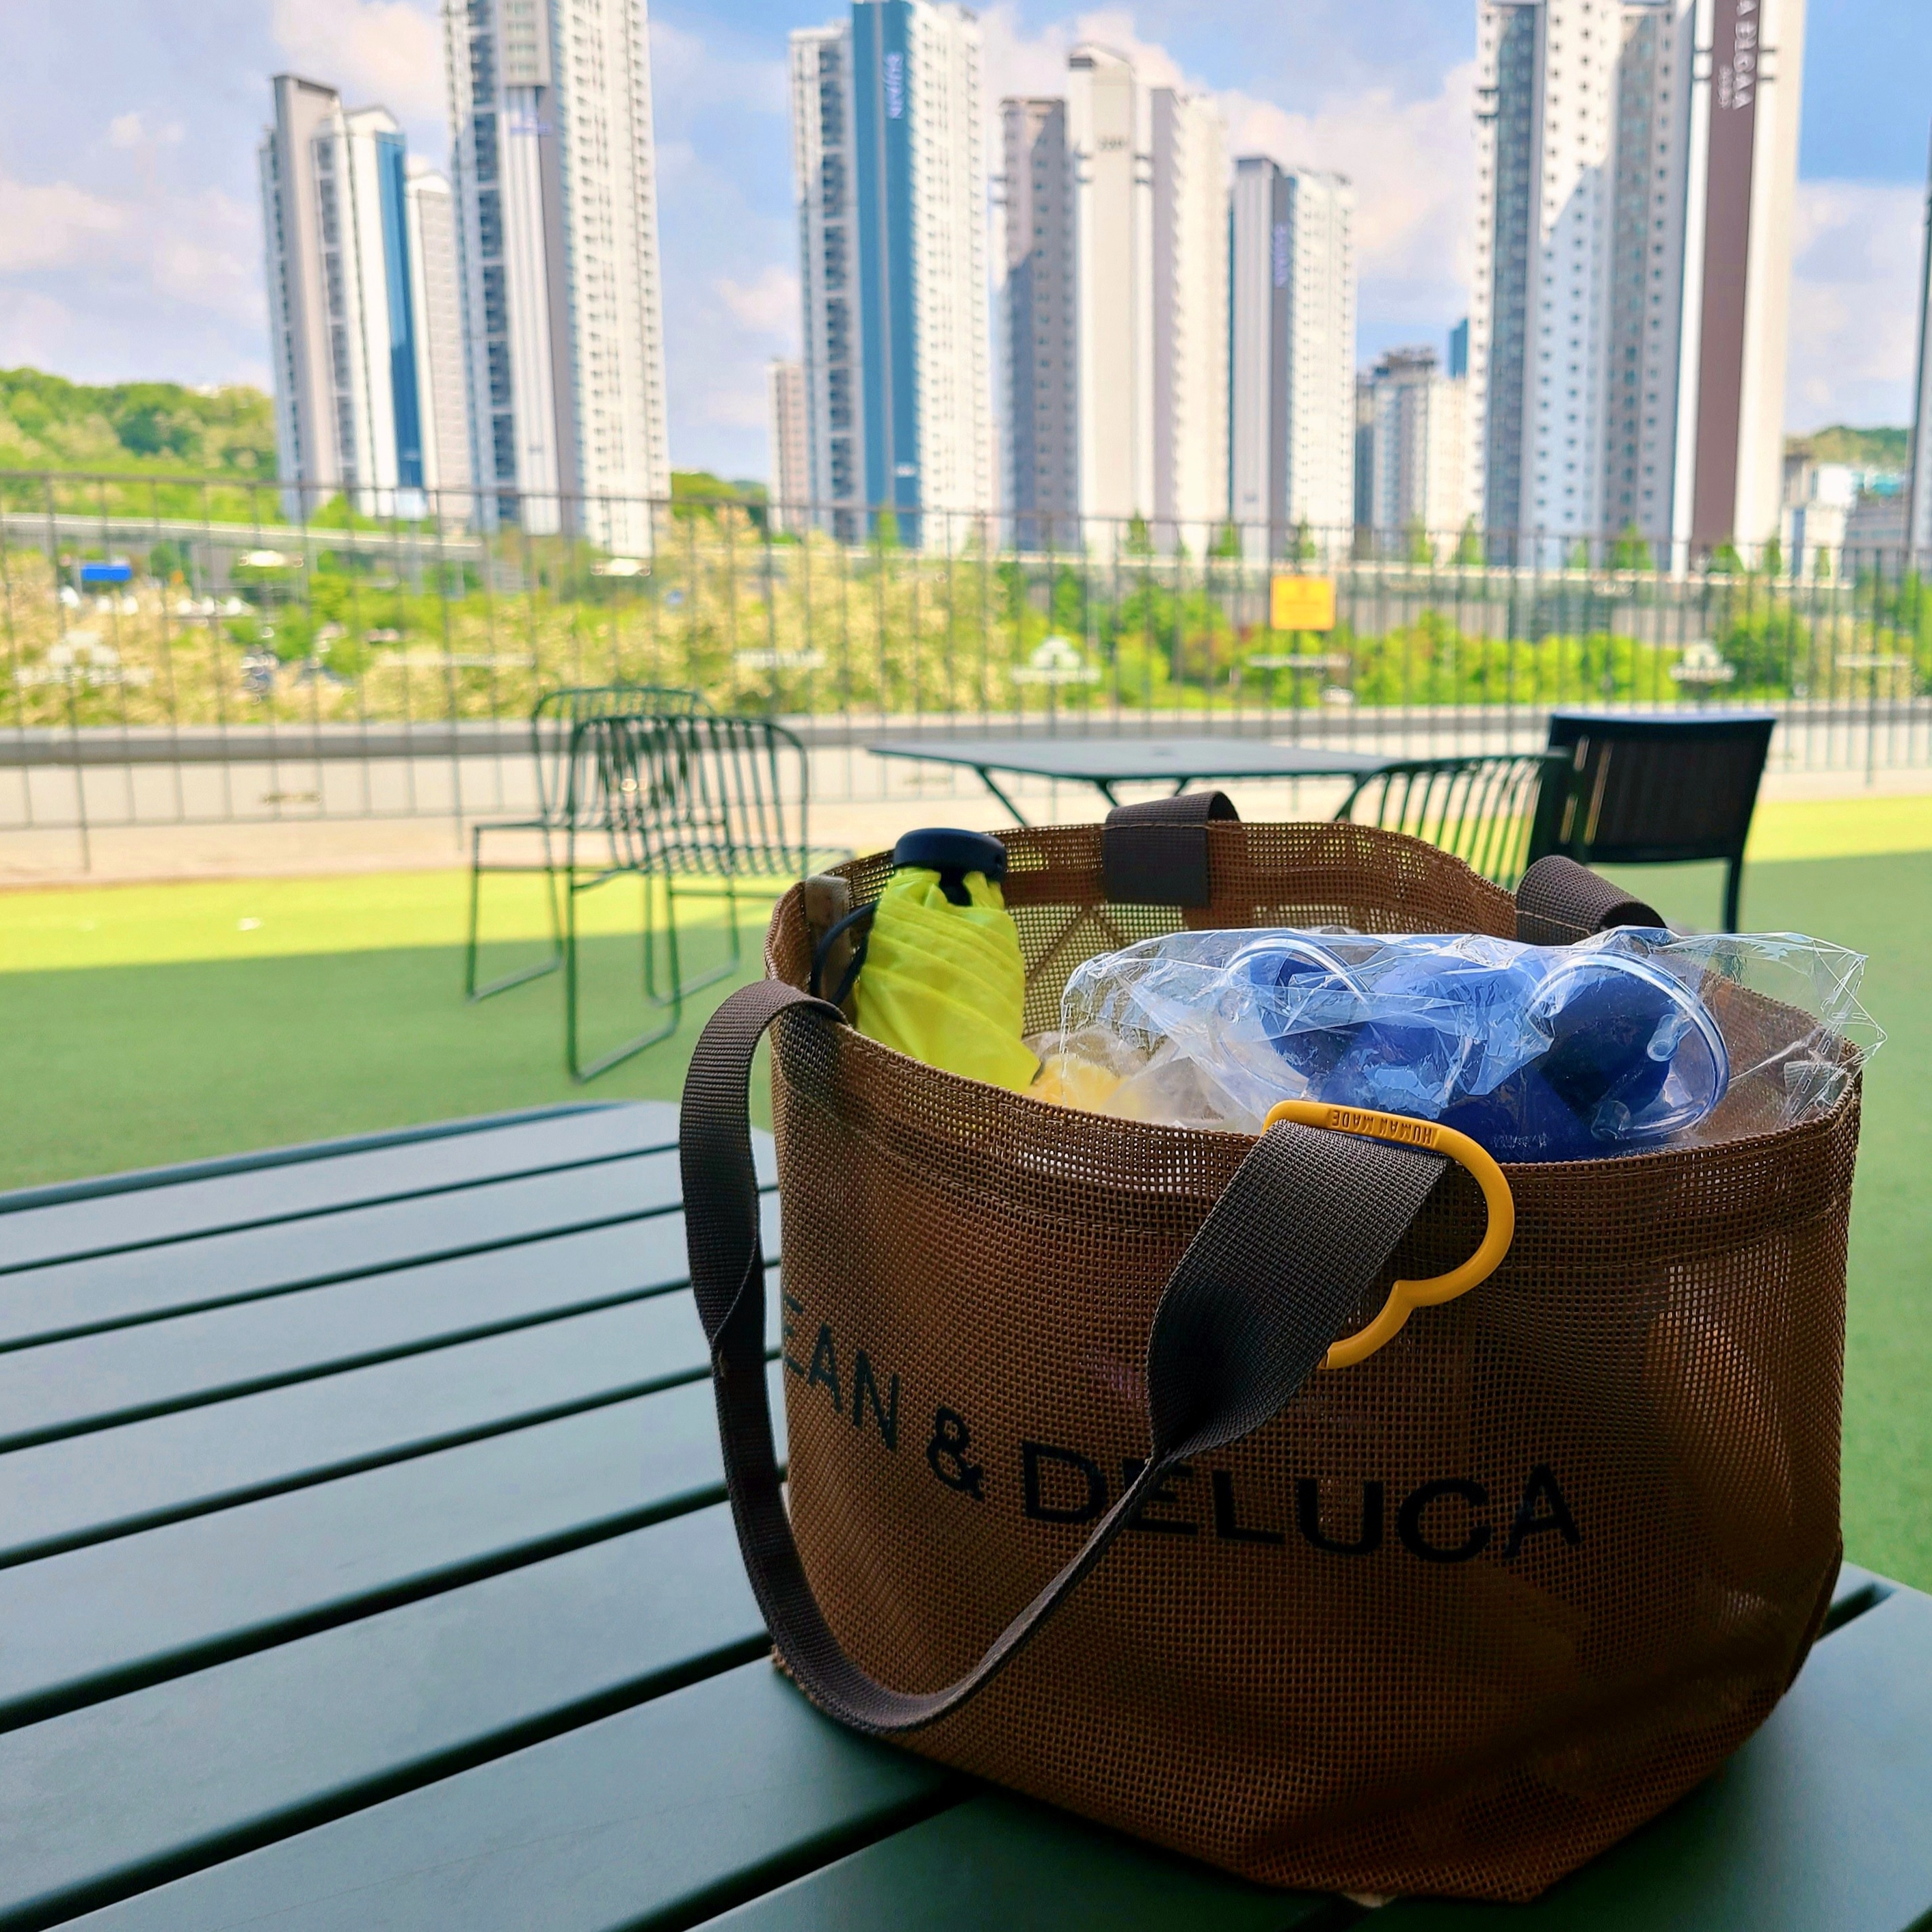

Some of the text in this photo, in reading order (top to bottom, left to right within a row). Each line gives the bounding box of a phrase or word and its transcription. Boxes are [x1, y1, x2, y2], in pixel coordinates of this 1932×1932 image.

[1331, 1110, 1434, 1146] HUMAN MADE
[926, 1406, 984, 1501] &
[1022, 1440, 1582, 1564] DELUCA
